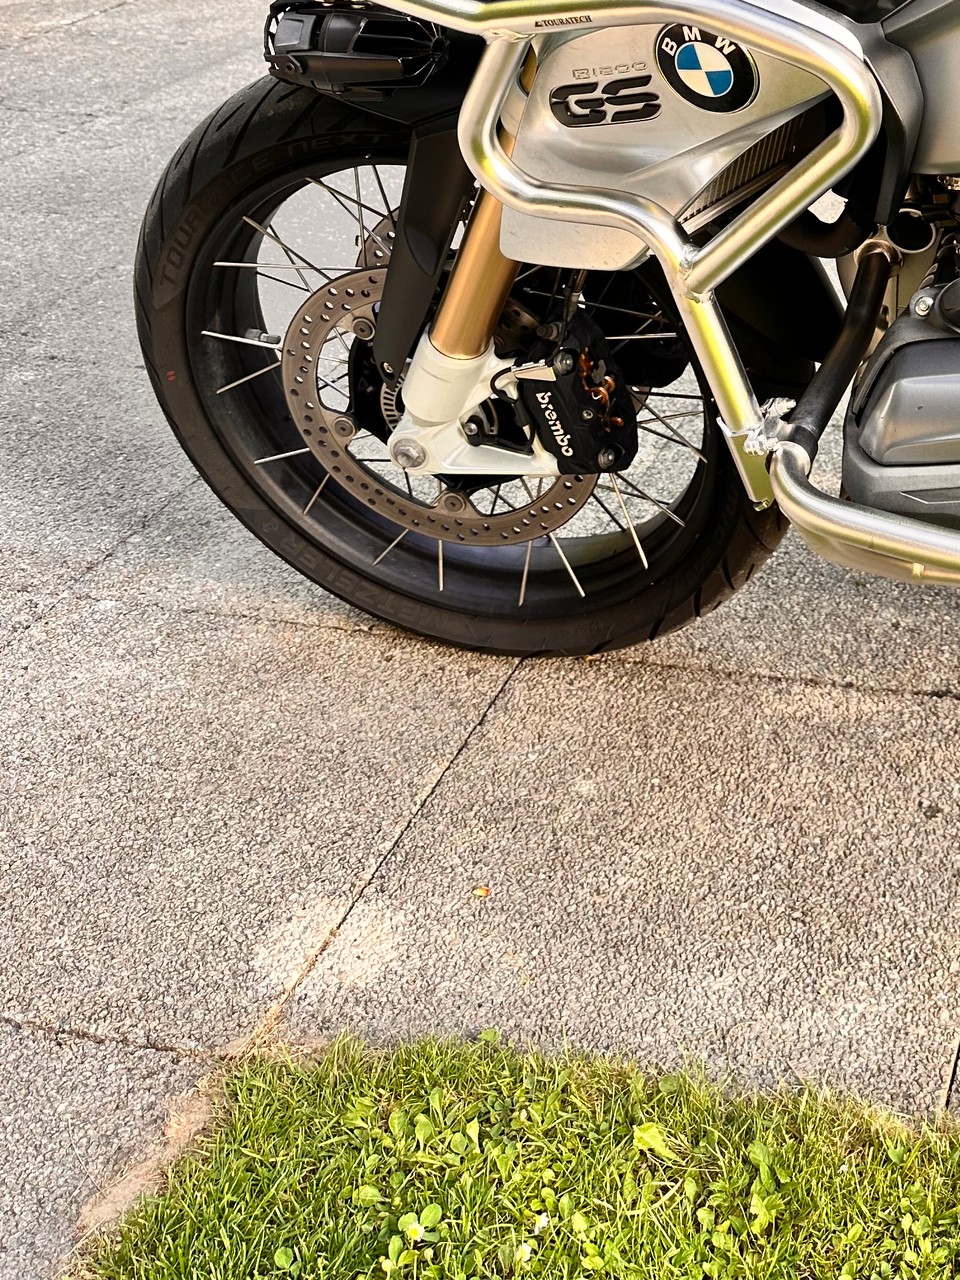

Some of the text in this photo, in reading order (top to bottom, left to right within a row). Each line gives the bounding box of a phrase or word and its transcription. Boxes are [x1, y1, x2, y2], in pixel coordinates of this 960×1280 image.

[542, 15, 593, 27] TOURATECH
[661, 25, 736, 56] BMW
[549, 74, 662, 128] GS
[536, 391, 573, 457] brembo
[280, 531, 449, 631] METZELER
